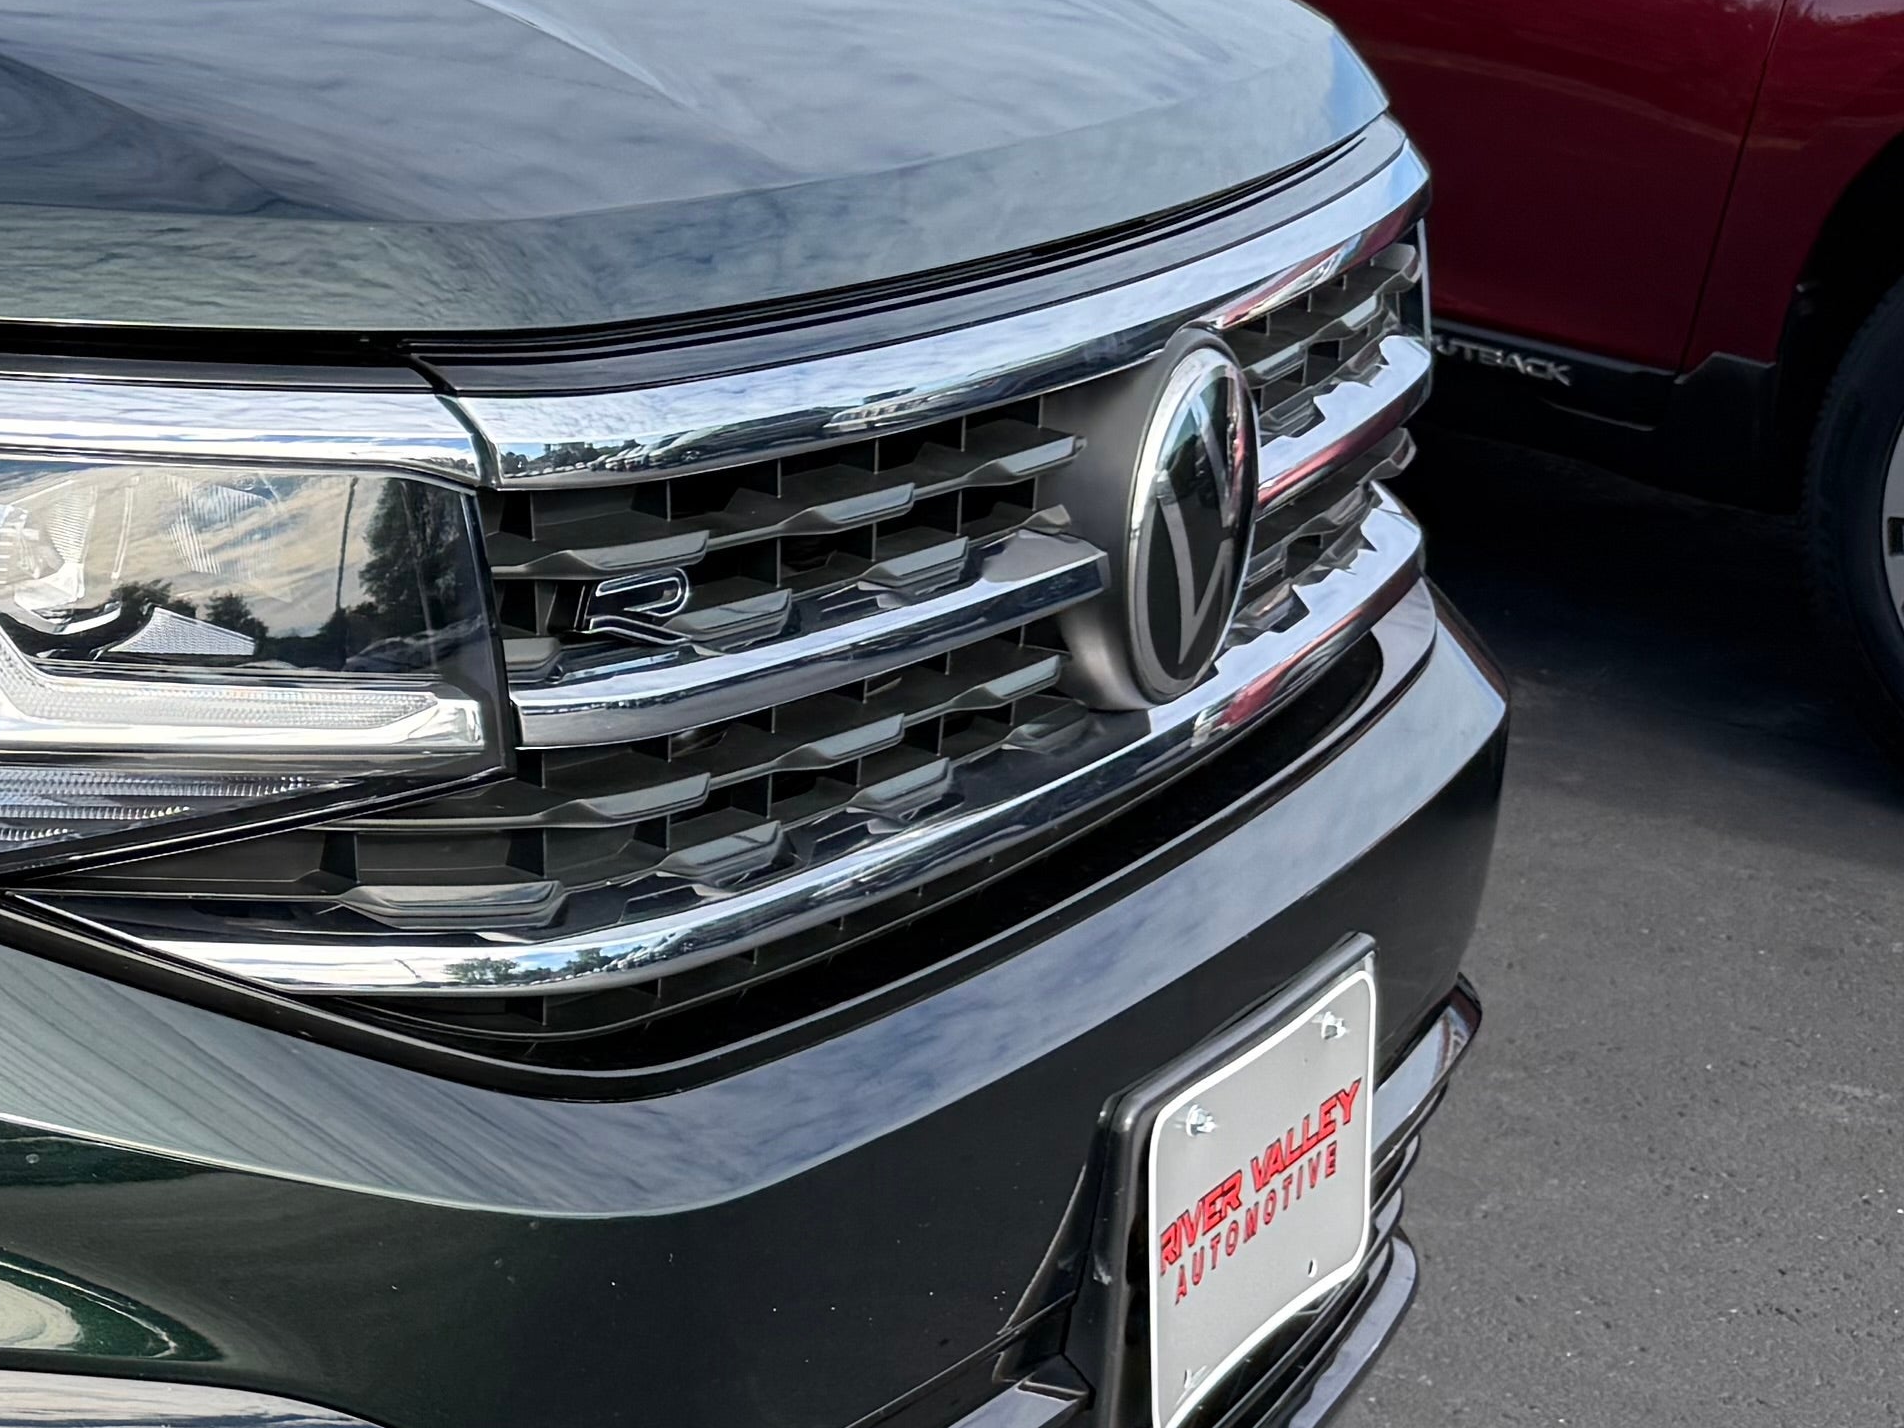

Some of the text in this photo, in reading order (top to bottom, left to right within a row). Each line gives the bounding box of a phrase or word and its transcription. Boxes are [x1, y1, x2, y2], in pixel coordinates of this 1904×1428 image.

[1158, 1077, 1363, 1277] RIVER VALLEY
[1174, 1139, 1338, 1306] AUTOMOTIVE
